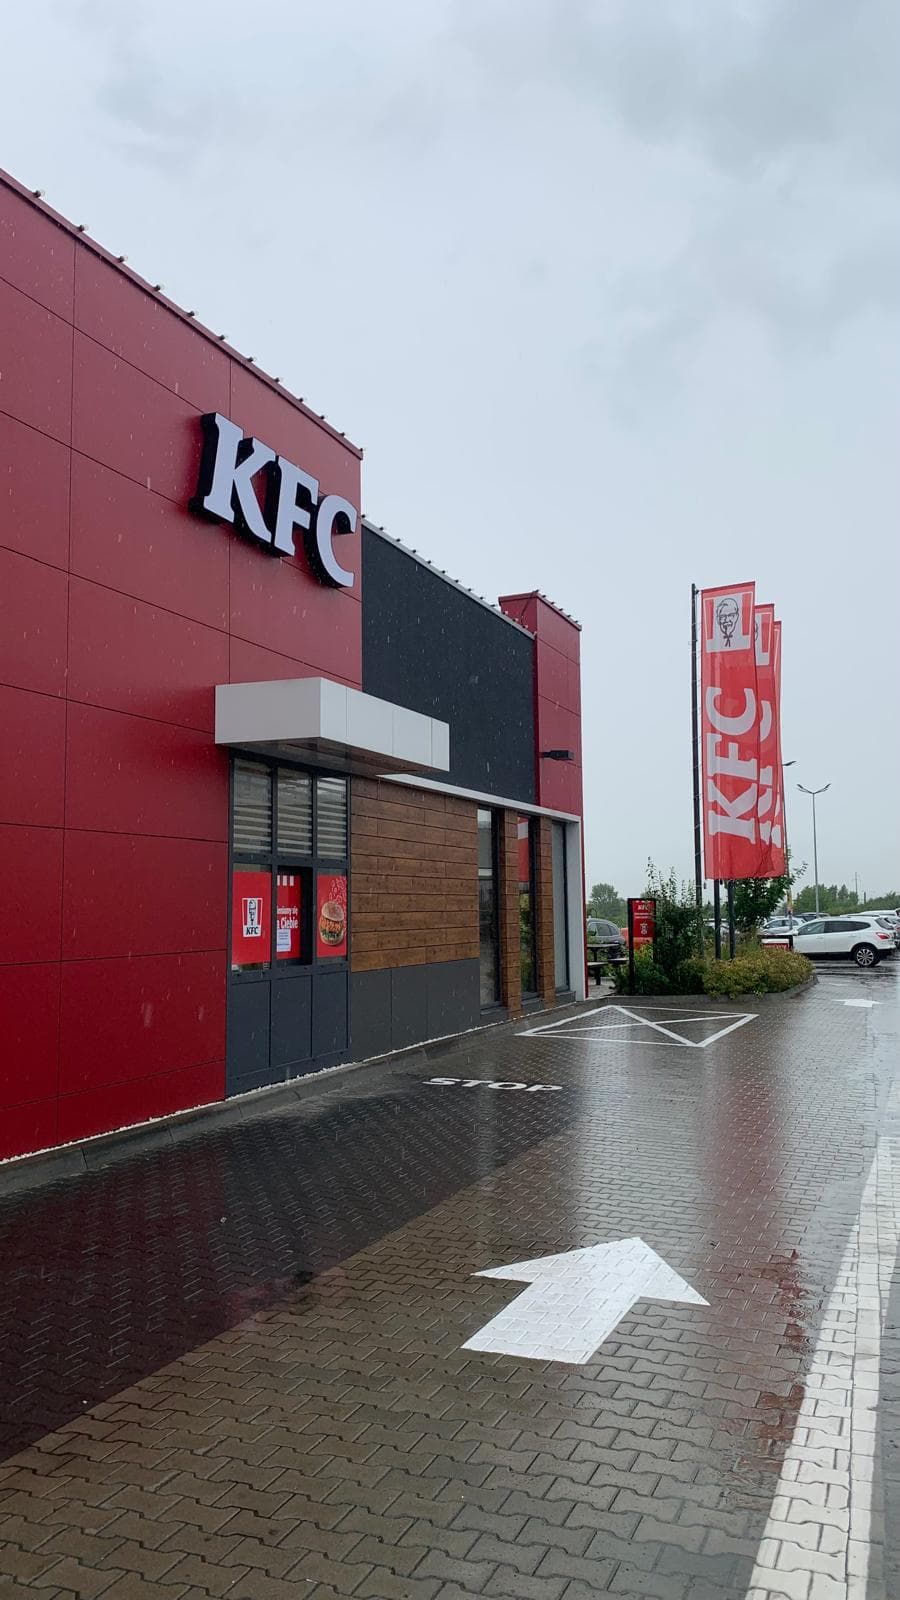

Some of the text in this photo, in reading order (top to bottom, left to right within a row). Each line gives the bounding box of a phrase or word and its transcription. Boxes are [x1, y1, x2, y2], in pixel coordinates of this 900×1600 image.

[202, 412, 358, 588] KFC
[705, 687, 758, 844] KFC
[246, 926, 259, 936] KFC
[421, 1077, 564, 1092] STOP
